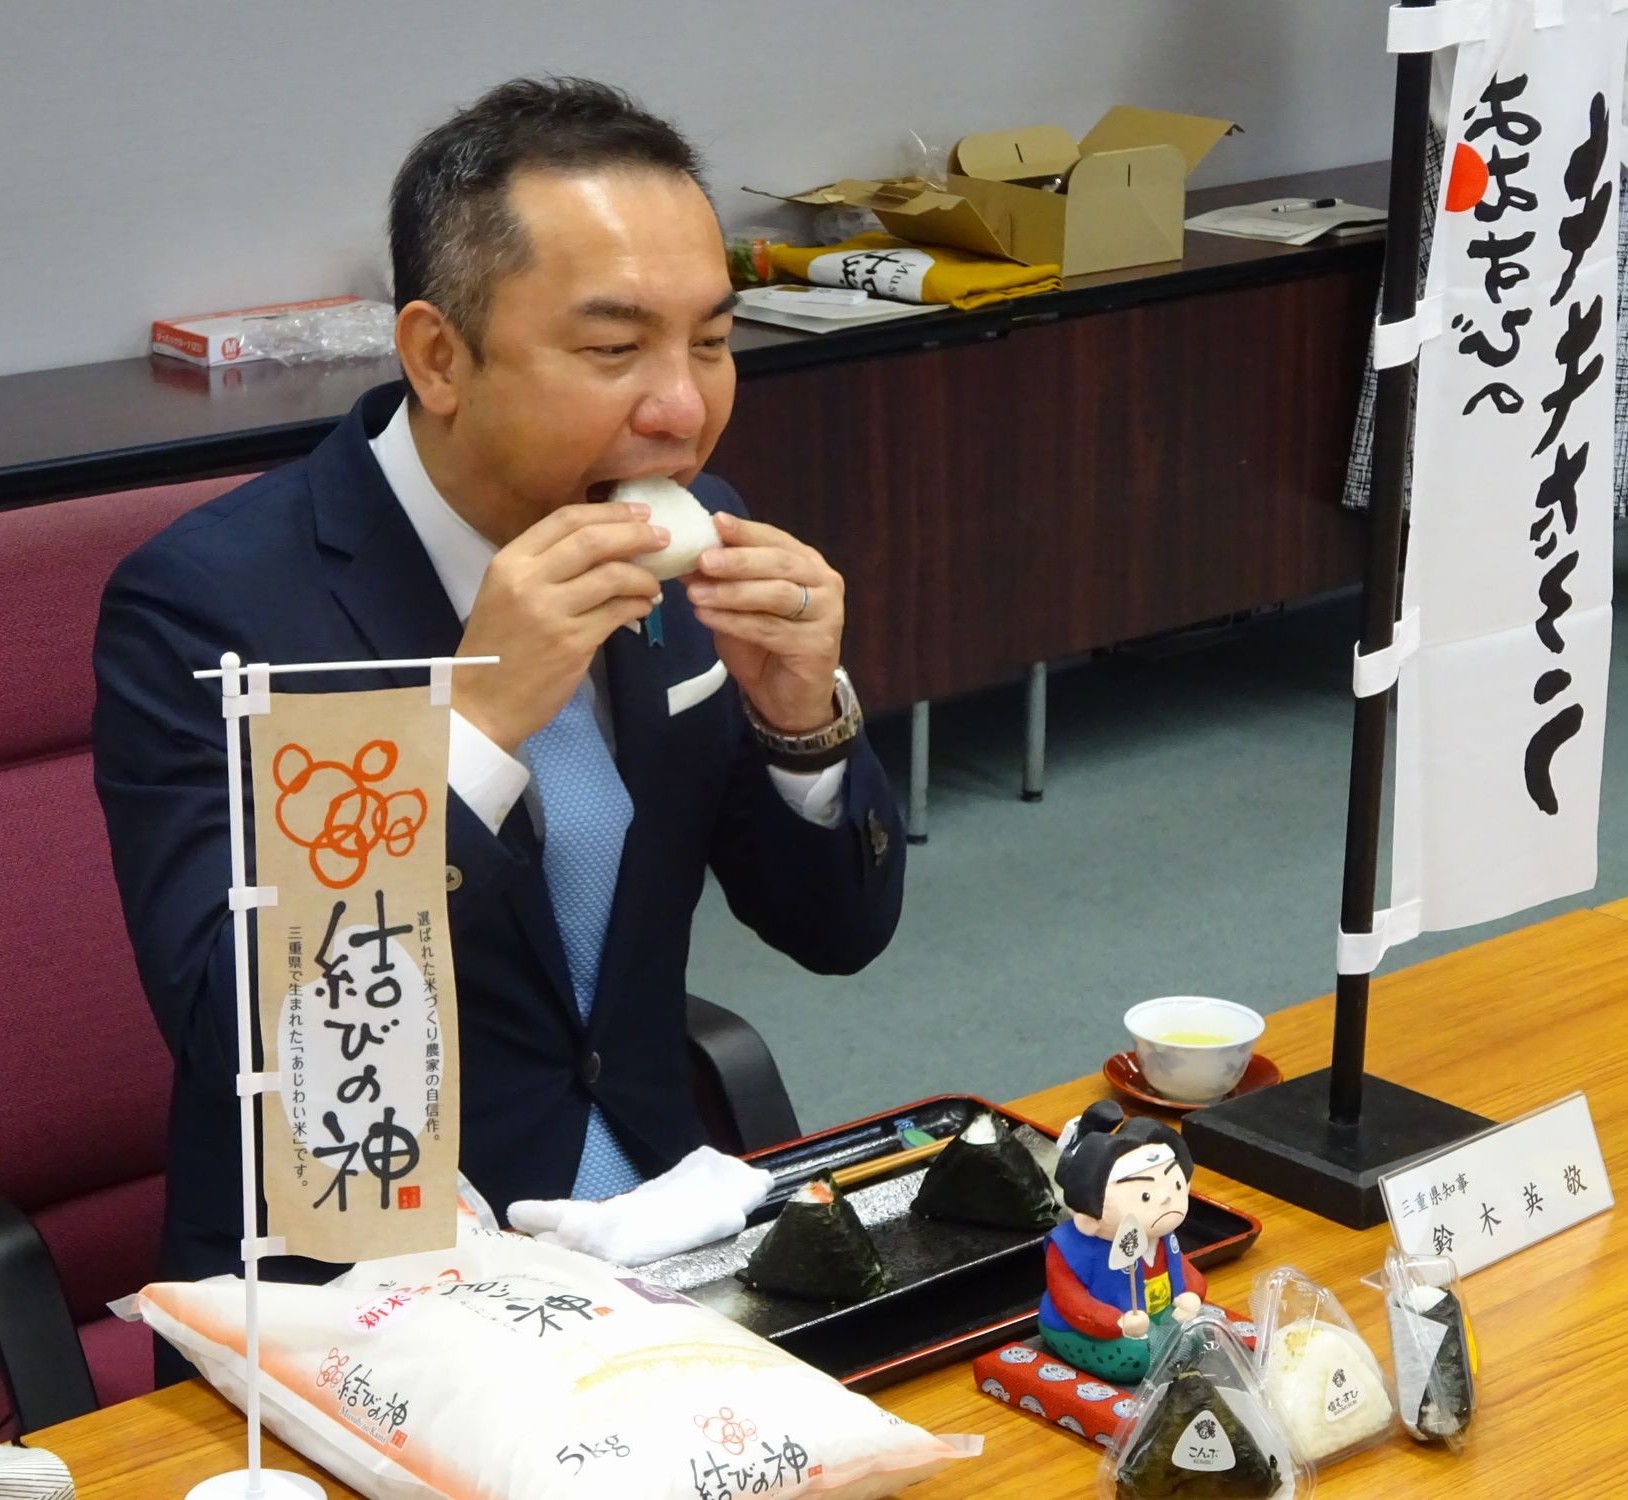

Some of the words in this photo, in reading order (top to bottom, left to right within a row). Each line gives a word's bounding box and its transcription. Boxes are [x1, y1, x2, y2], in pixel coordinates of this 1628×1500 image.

[287, 926, 308, 1187] 三重県で生まれた「あじわい米」です。
[313, 890, 420, 1212] 結びの神
[417, 911, 441, 1142] 選ばれた米づくり農家の自信作。
[1402, 1173, 1470, 1219] 三重県知事
[337, 1363, 409, 1434] 結びの神
[555, 1432, 631, 1476] 5kg
[690, 1434, 809, 1499] 結びの神
[1189, 1446, 1221, 1459] こんぶ
